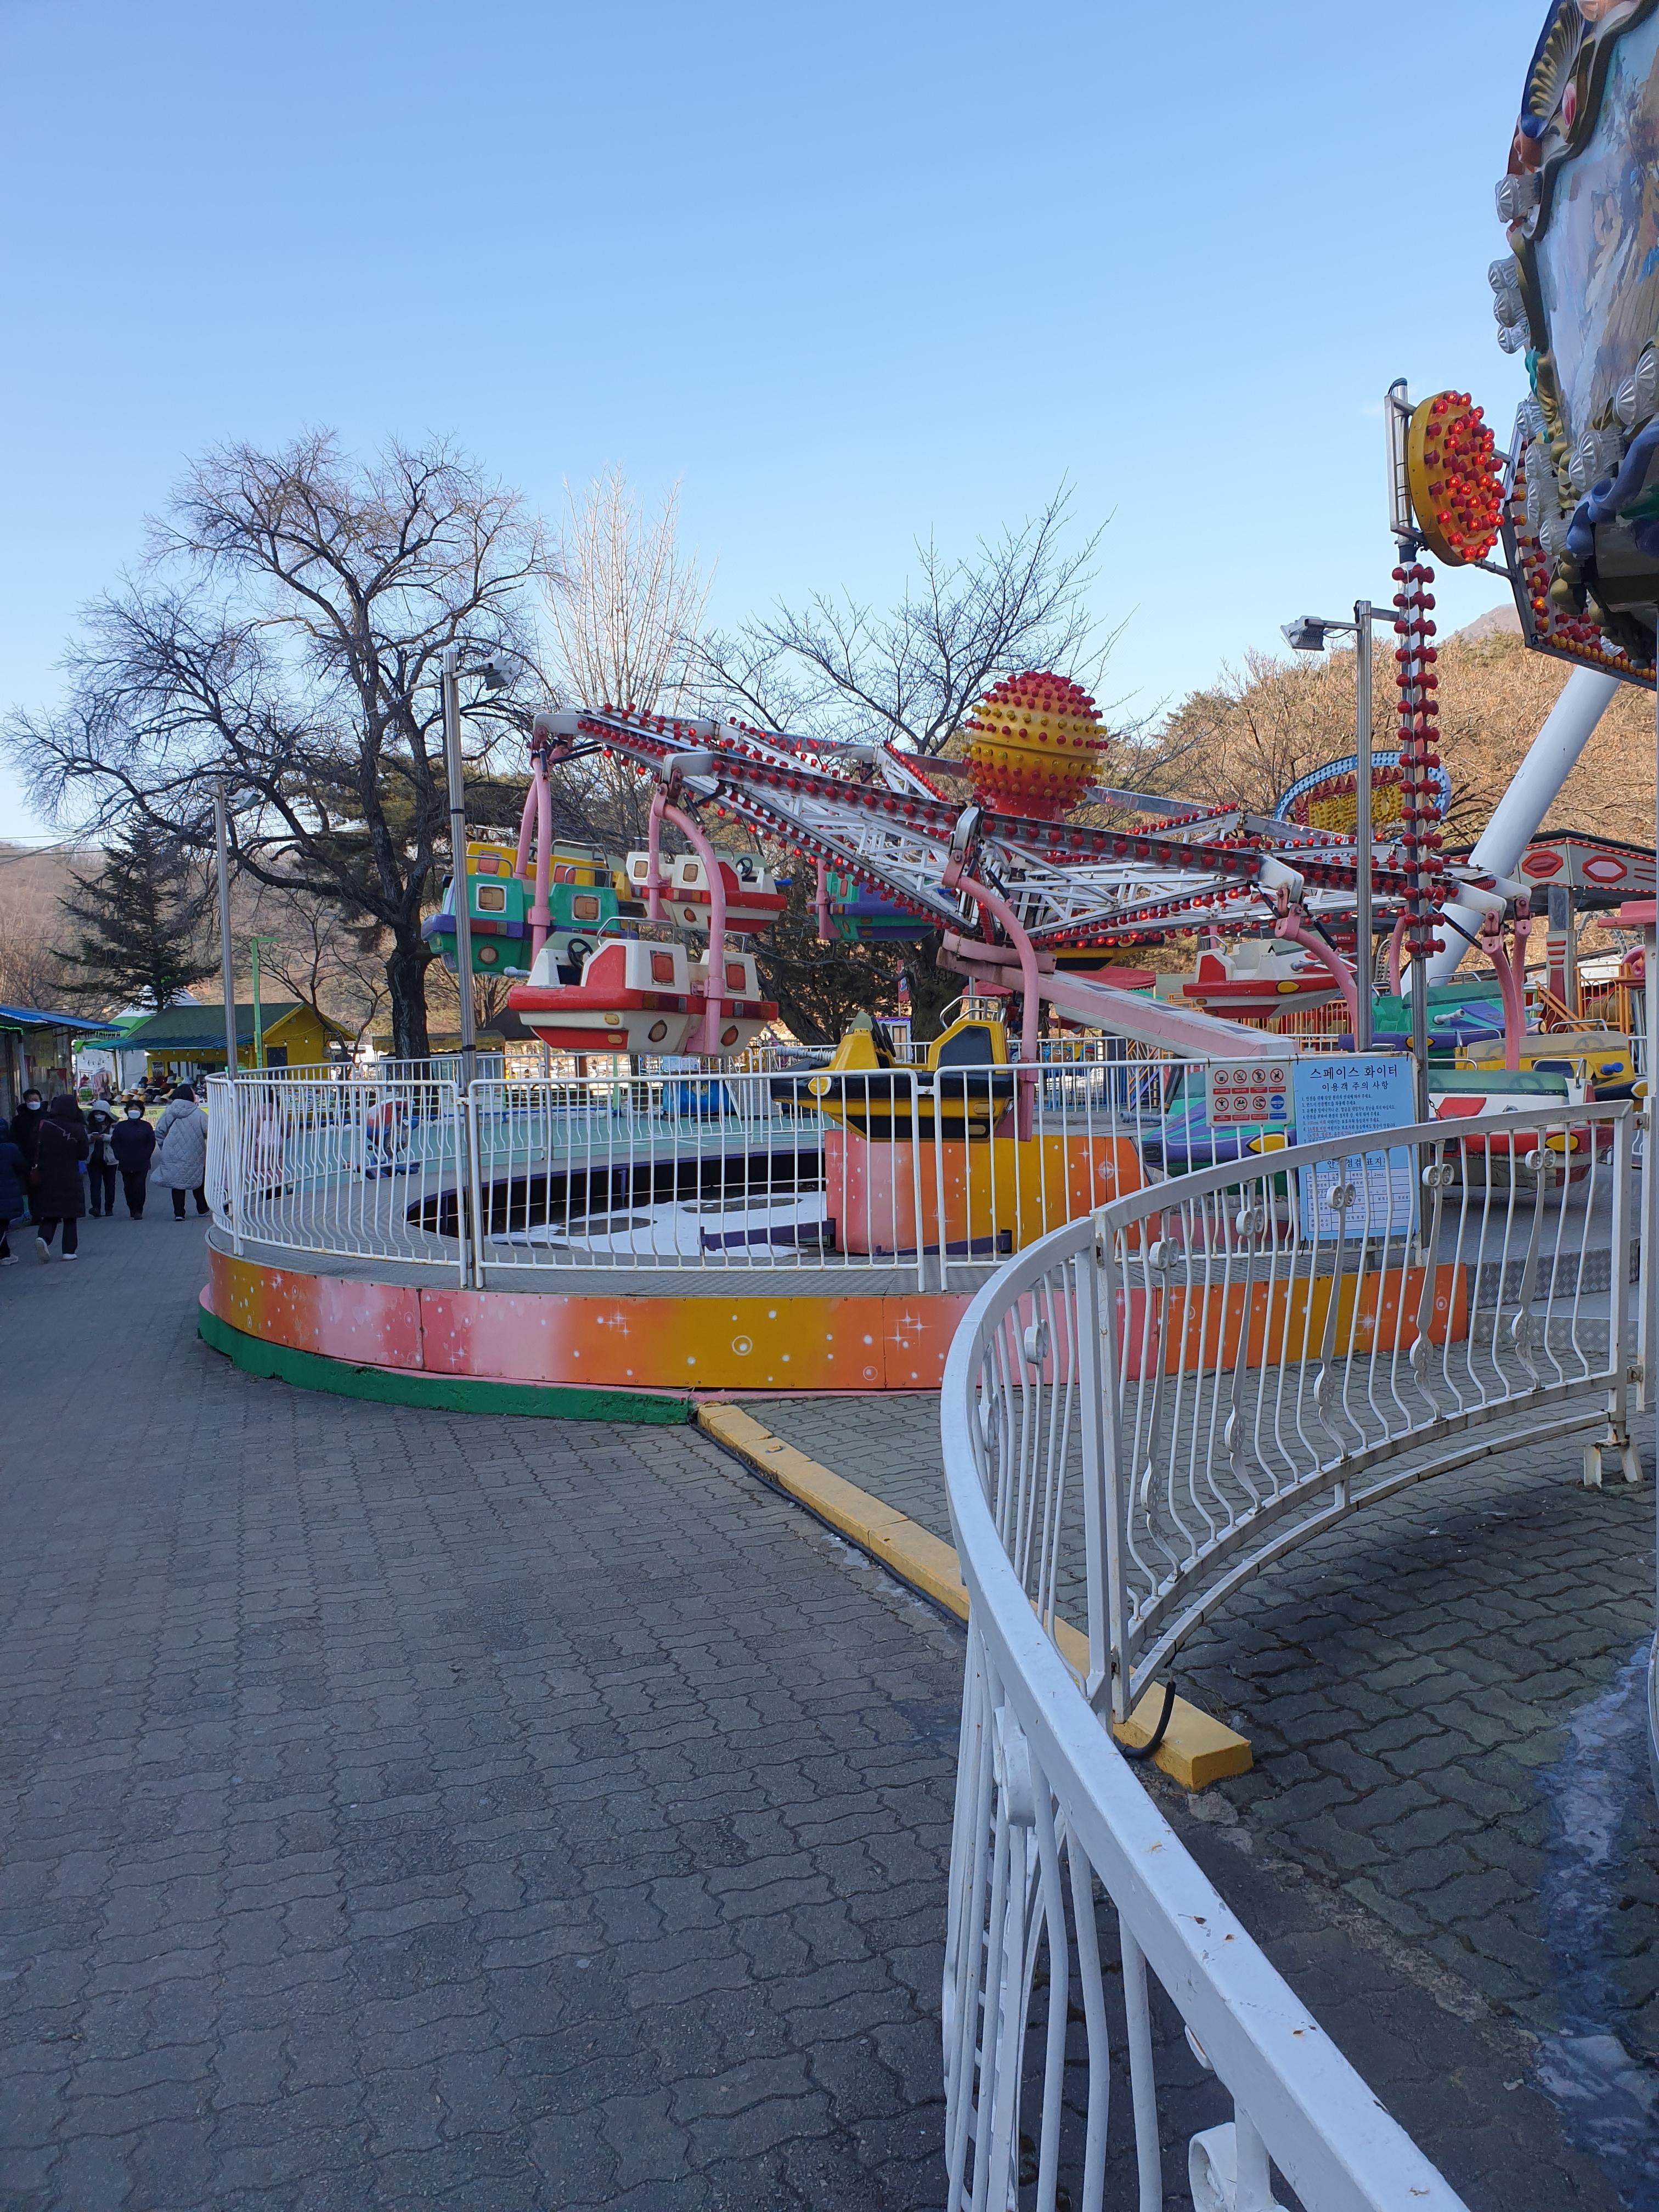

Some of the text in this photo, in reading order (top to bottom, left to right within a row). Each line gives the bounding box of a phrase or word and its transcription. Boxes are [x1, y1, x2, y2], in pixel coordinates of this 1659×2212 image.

[1310, 1064, 1398, 1080] 스페이스 화이터
[1322, 1080, 1389, 1092] 이용객 주의 사항
